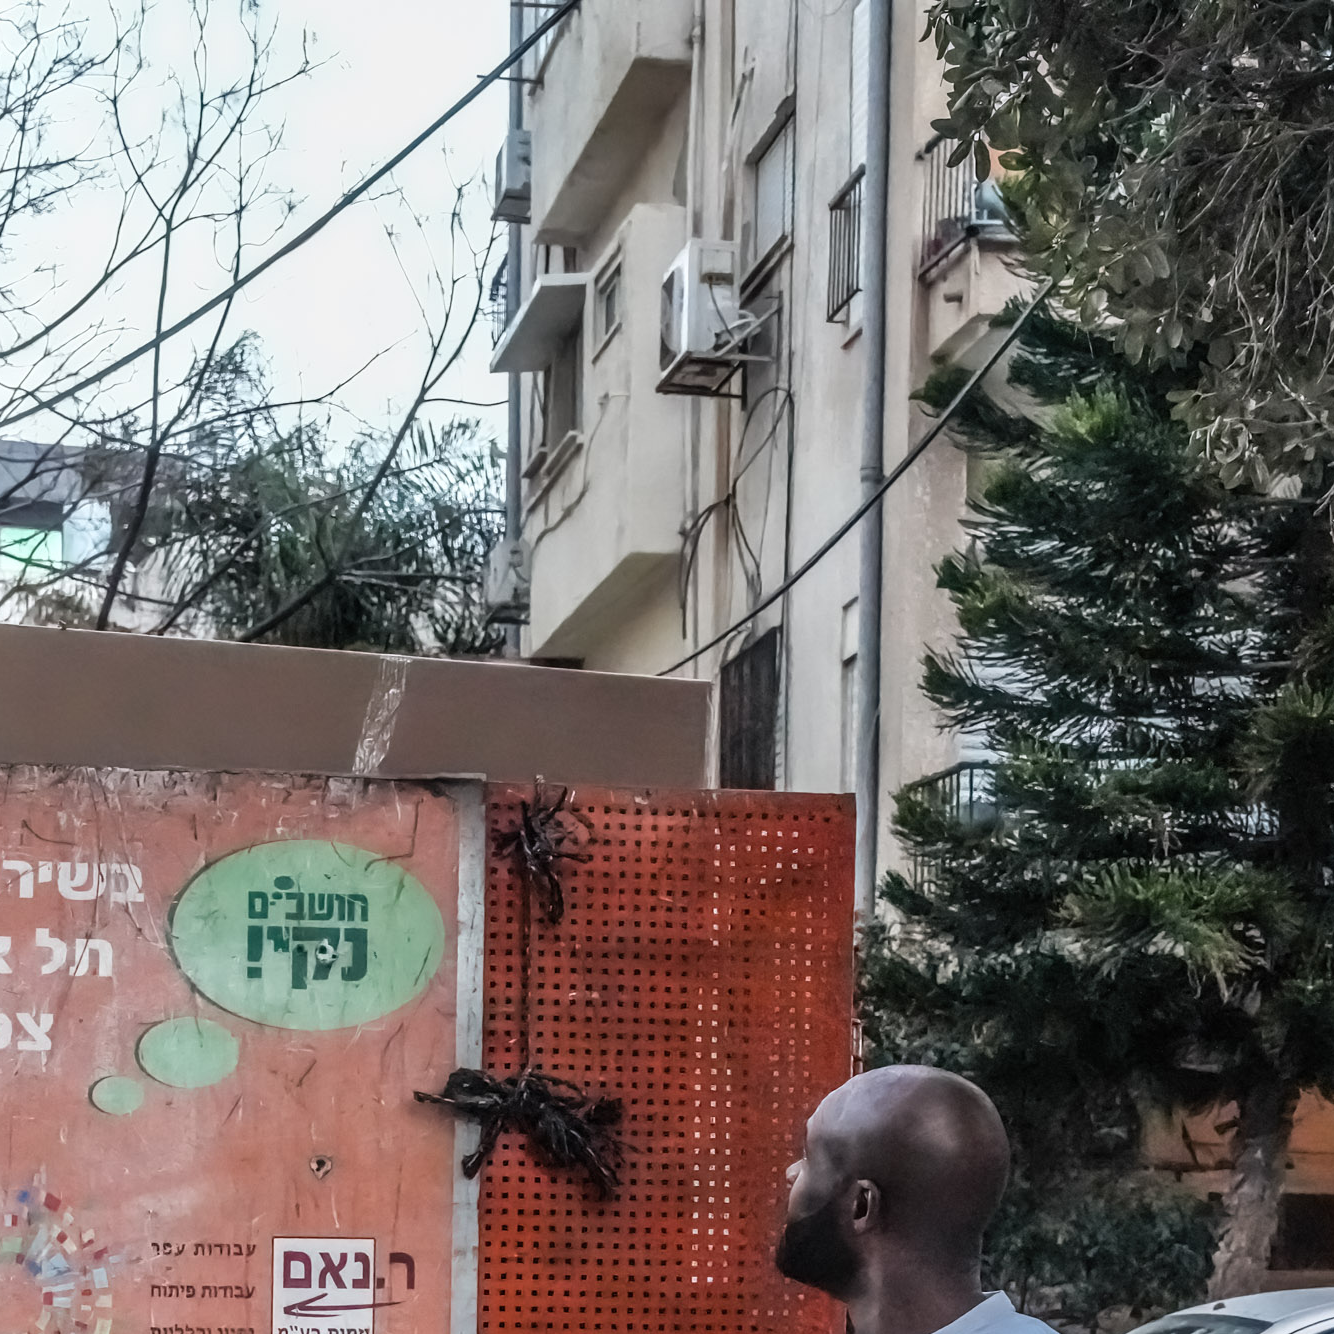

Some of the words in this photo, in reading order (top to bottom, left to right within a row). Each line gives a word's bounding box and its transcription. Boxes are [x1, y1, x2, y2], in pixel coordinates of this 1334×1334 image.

[36, 927, 114, 977] תל
[246, 925, 369, 990] נקי!
[151, 1242, 186, 1257] עפר
[193, 1243, 257, 1257] עבודות
[150, 1284, 196, 1299] פיתוח
[200, 1285, 256, 1299] עבודות
